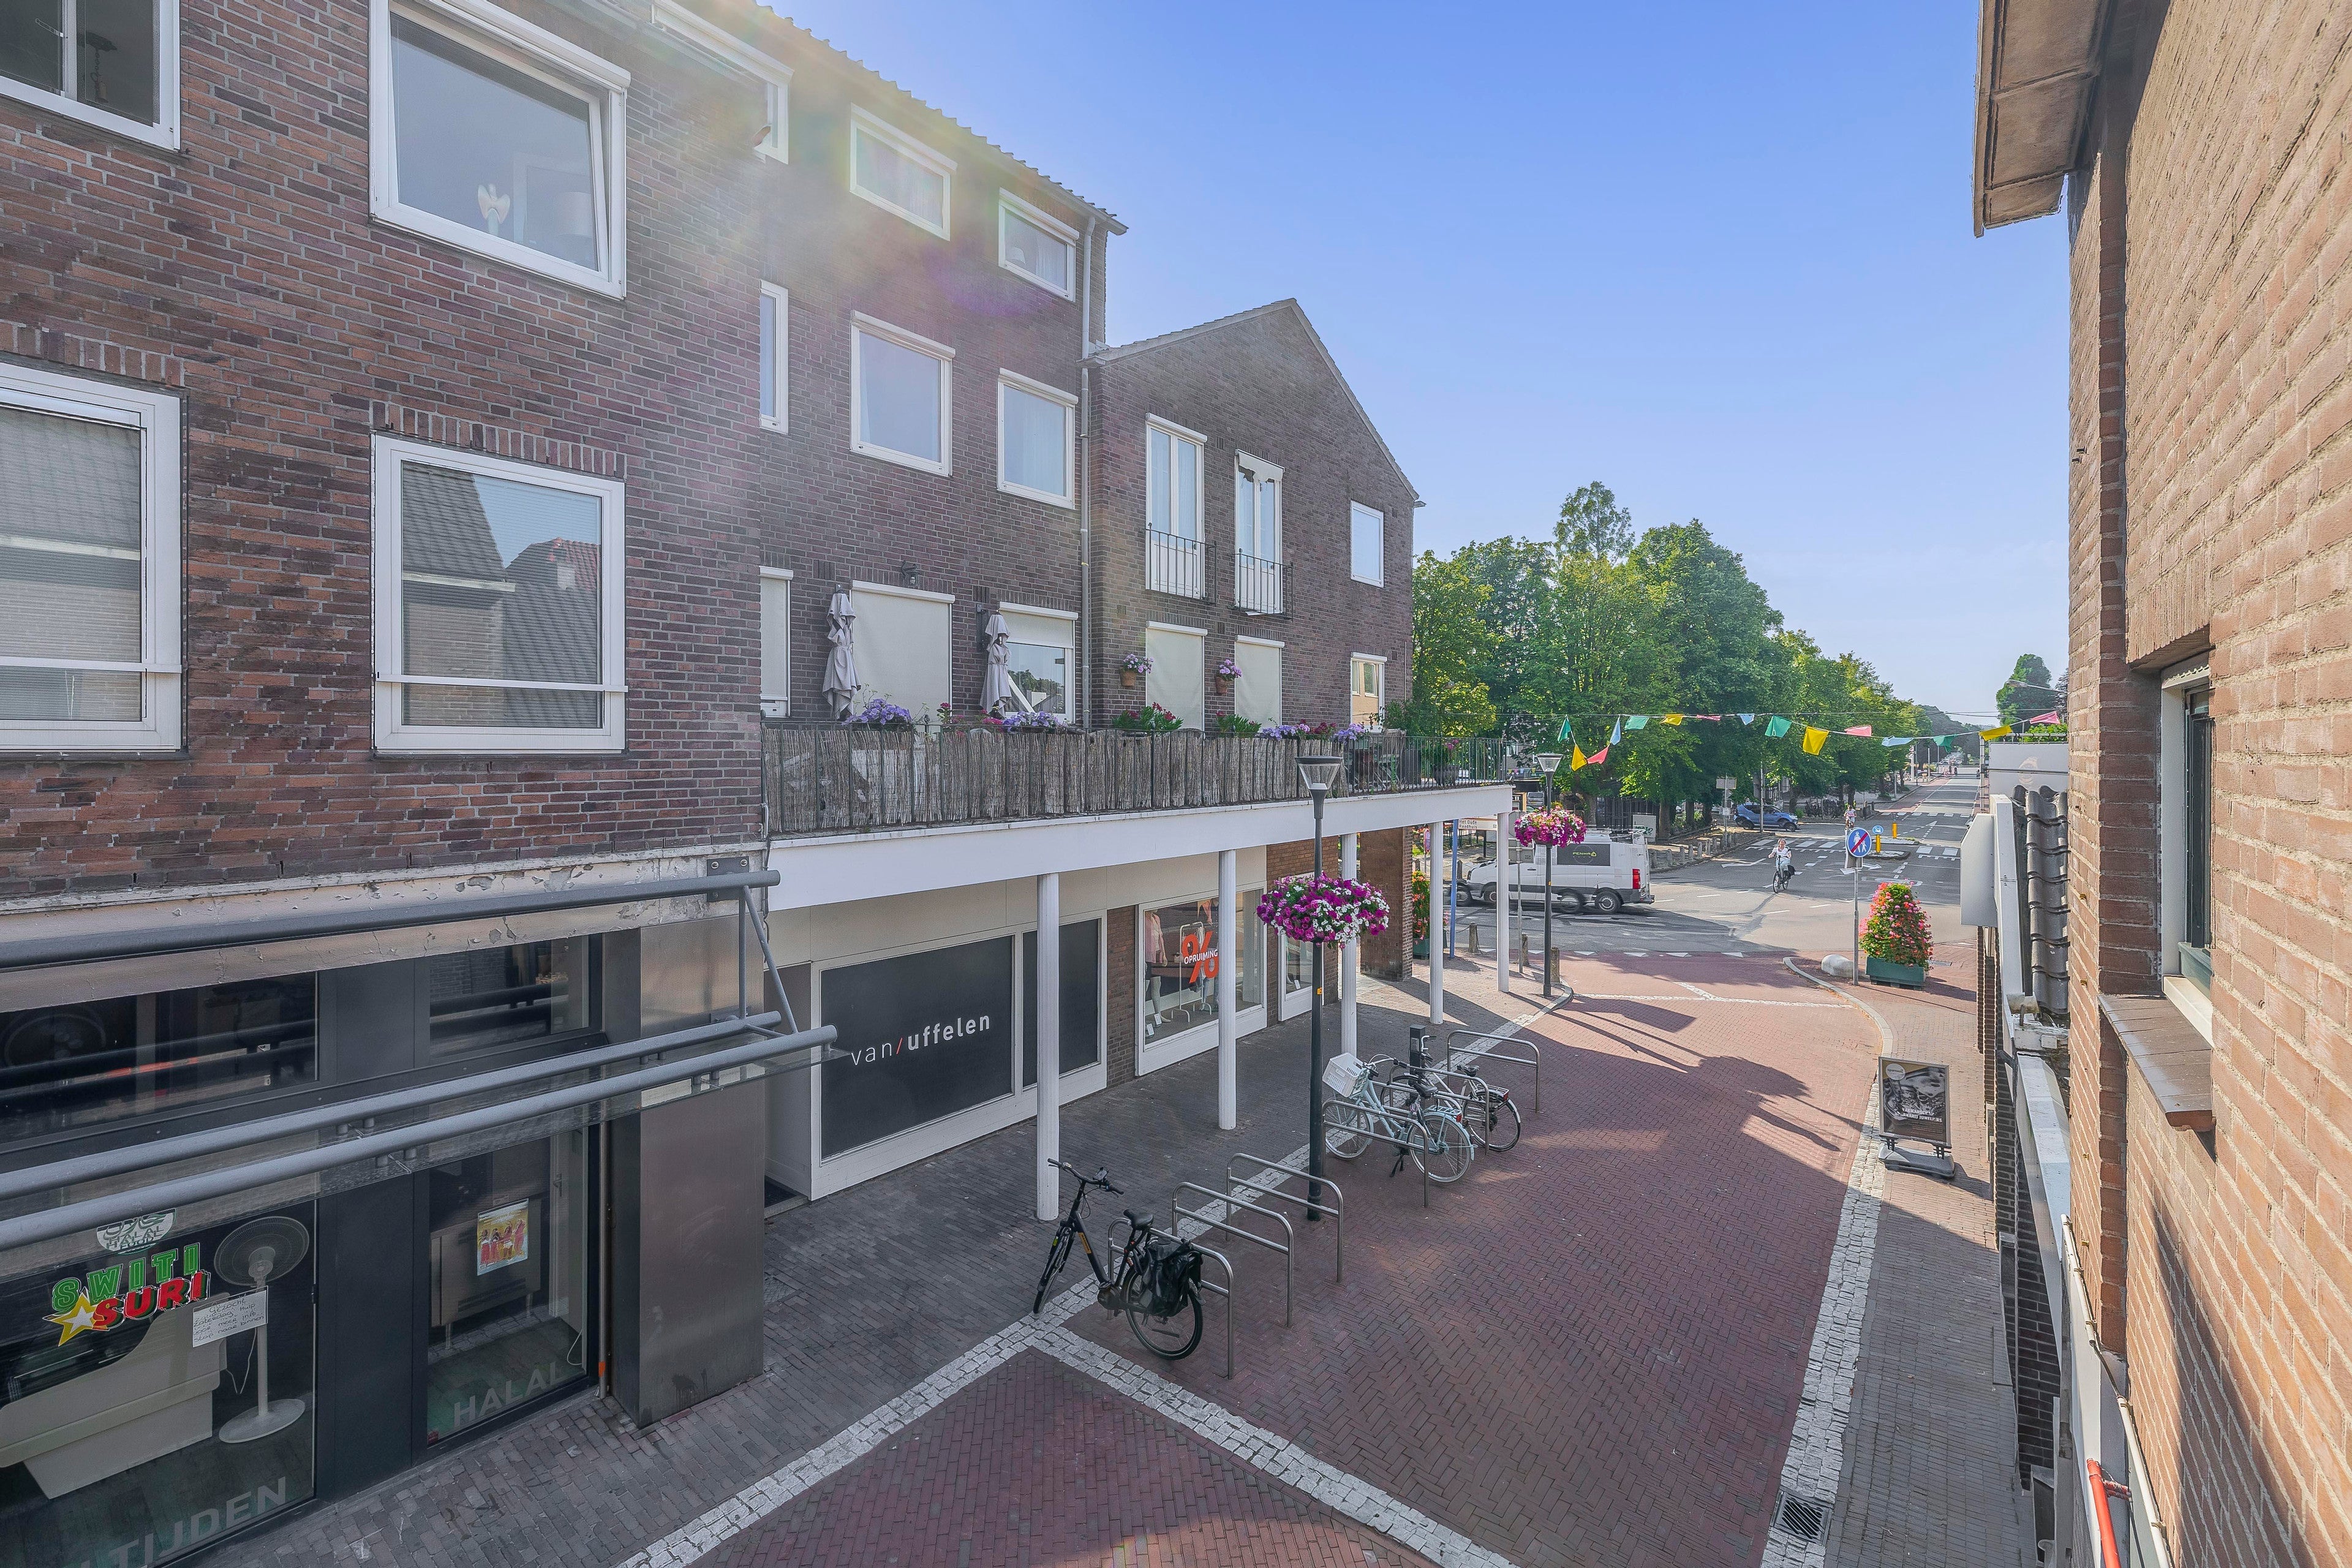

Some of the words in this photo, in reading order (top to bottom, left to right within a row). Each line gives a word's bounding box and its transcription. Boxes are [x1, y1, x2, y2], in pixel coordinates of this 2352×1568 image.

[1183, 949, 1218, 965] OPRUIMING
[51, 1243, 201, 1313] SWITI
[92, 1270, 210, 1331] SURI
[454, 1361, 562, 1429] HALAL
[78, 1477, 286, 1568] TIJDEN
